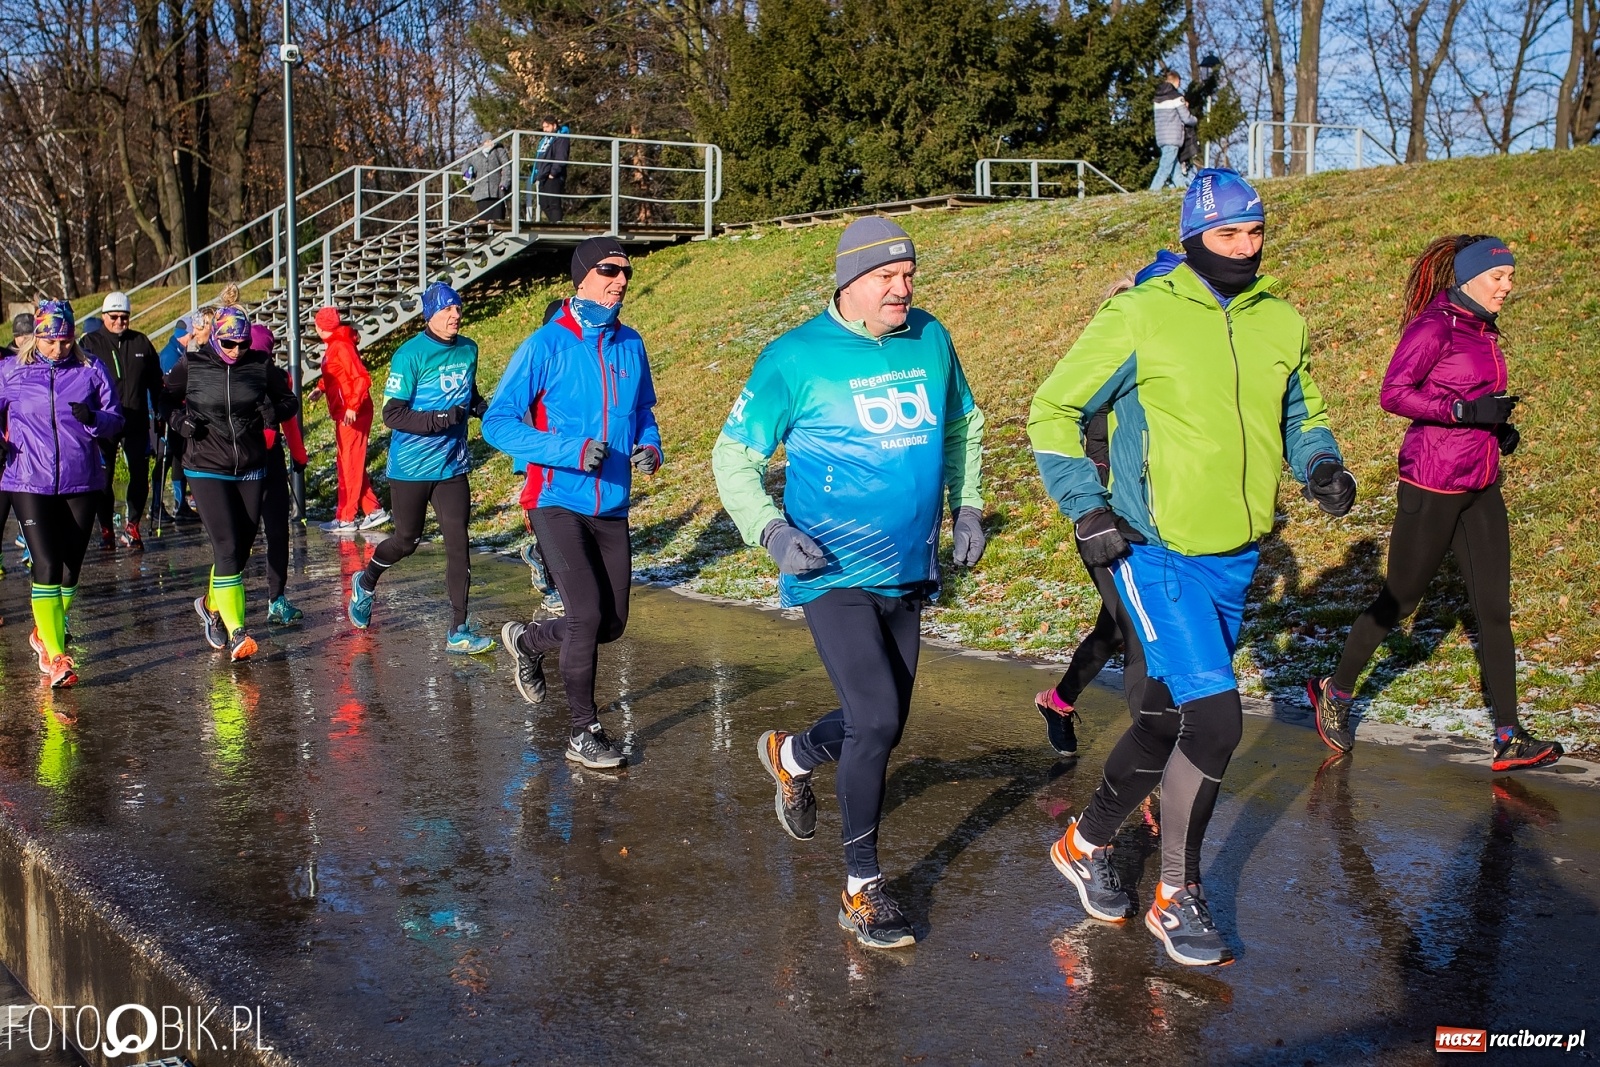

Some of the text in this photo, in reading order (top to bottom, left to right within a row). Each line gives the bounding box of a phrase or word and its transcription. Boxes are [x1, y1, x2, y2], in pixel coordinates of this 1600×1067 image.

[1202, 176, 1216, 211] UNNERS
[849, 367, 927, 389] BiegamBoLubię
[853, 383, 937, 434] bbl
[881, 434, 928, 450] RACIBÓRZ
